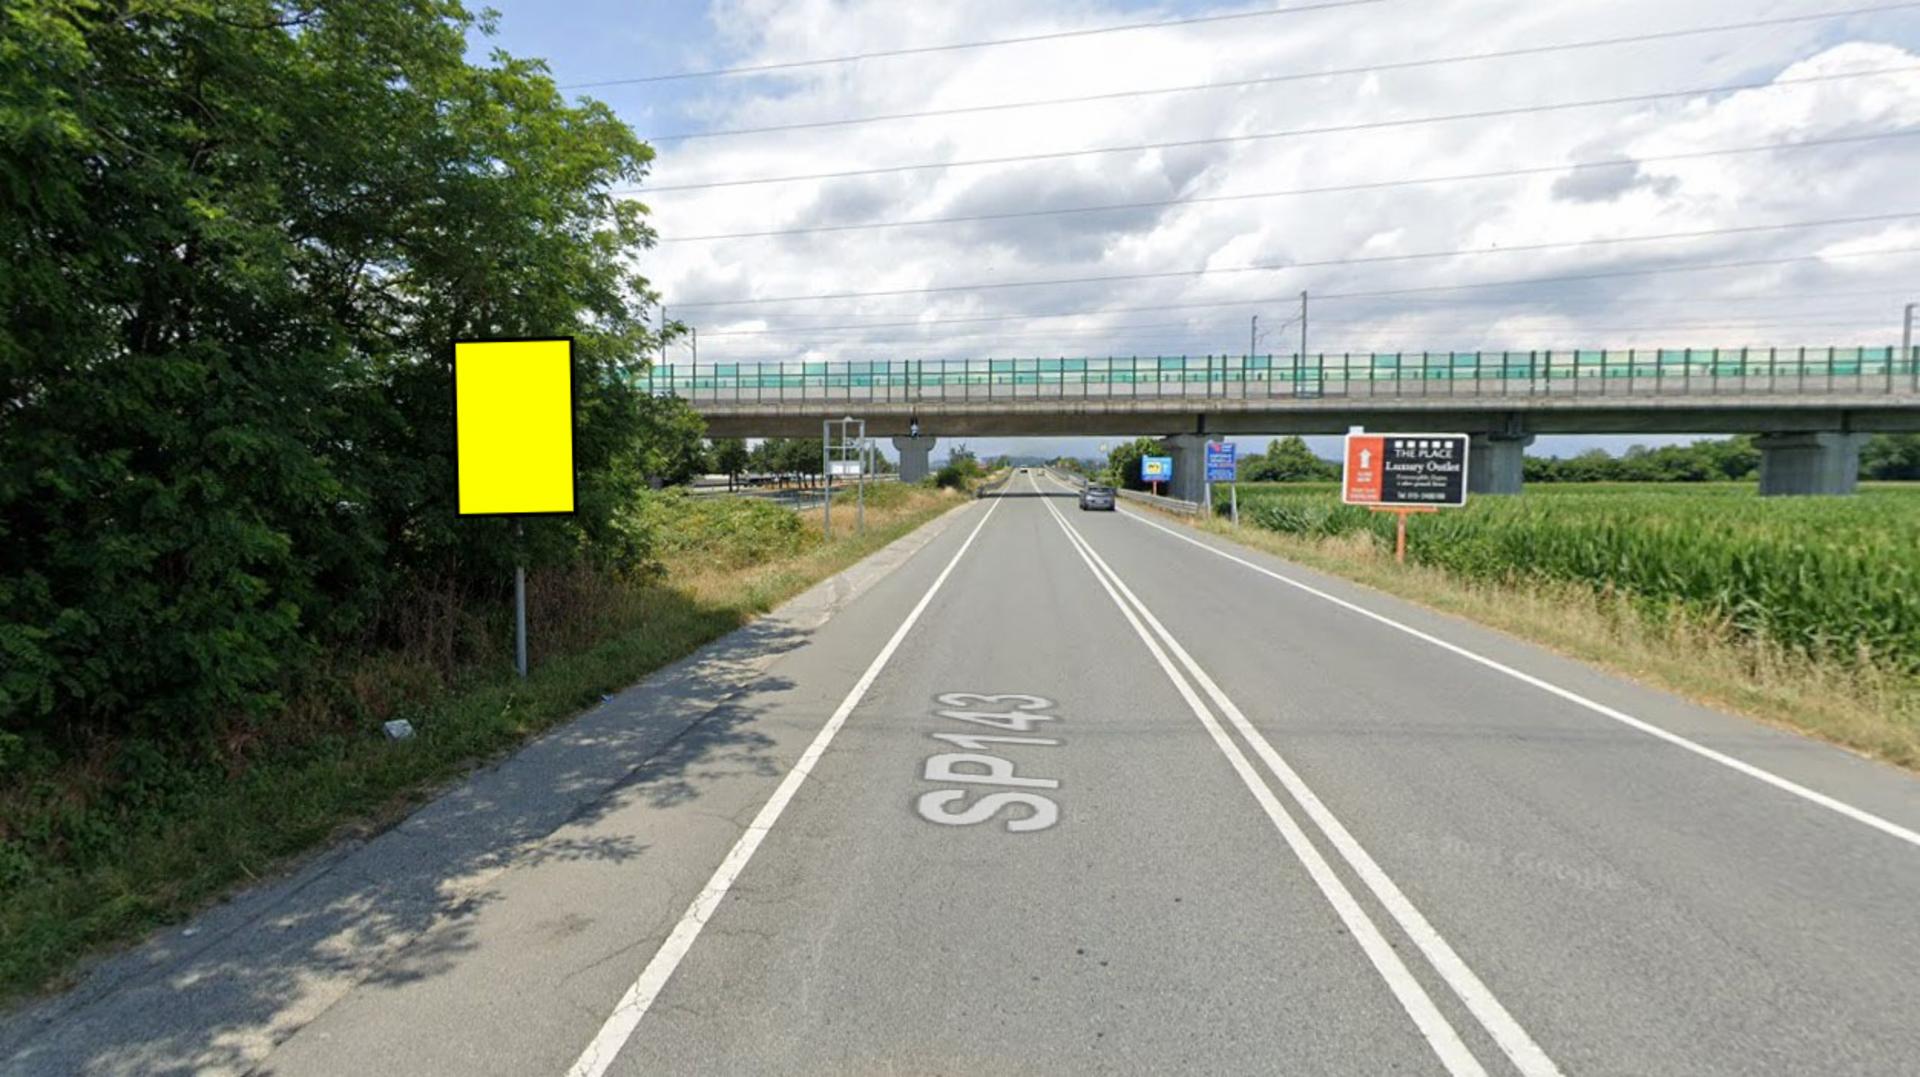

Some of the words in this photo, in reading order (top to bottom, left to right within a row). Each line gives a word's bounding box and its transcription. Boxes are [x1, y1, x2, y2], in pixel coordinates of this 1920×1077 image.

[1394, 449, 1415, 459] THE
[1419, 449, 1452, 459] PLACE
[1385, 461, 1424, 473] Luxury
[1426, 461, 1460, 472] Outlet
